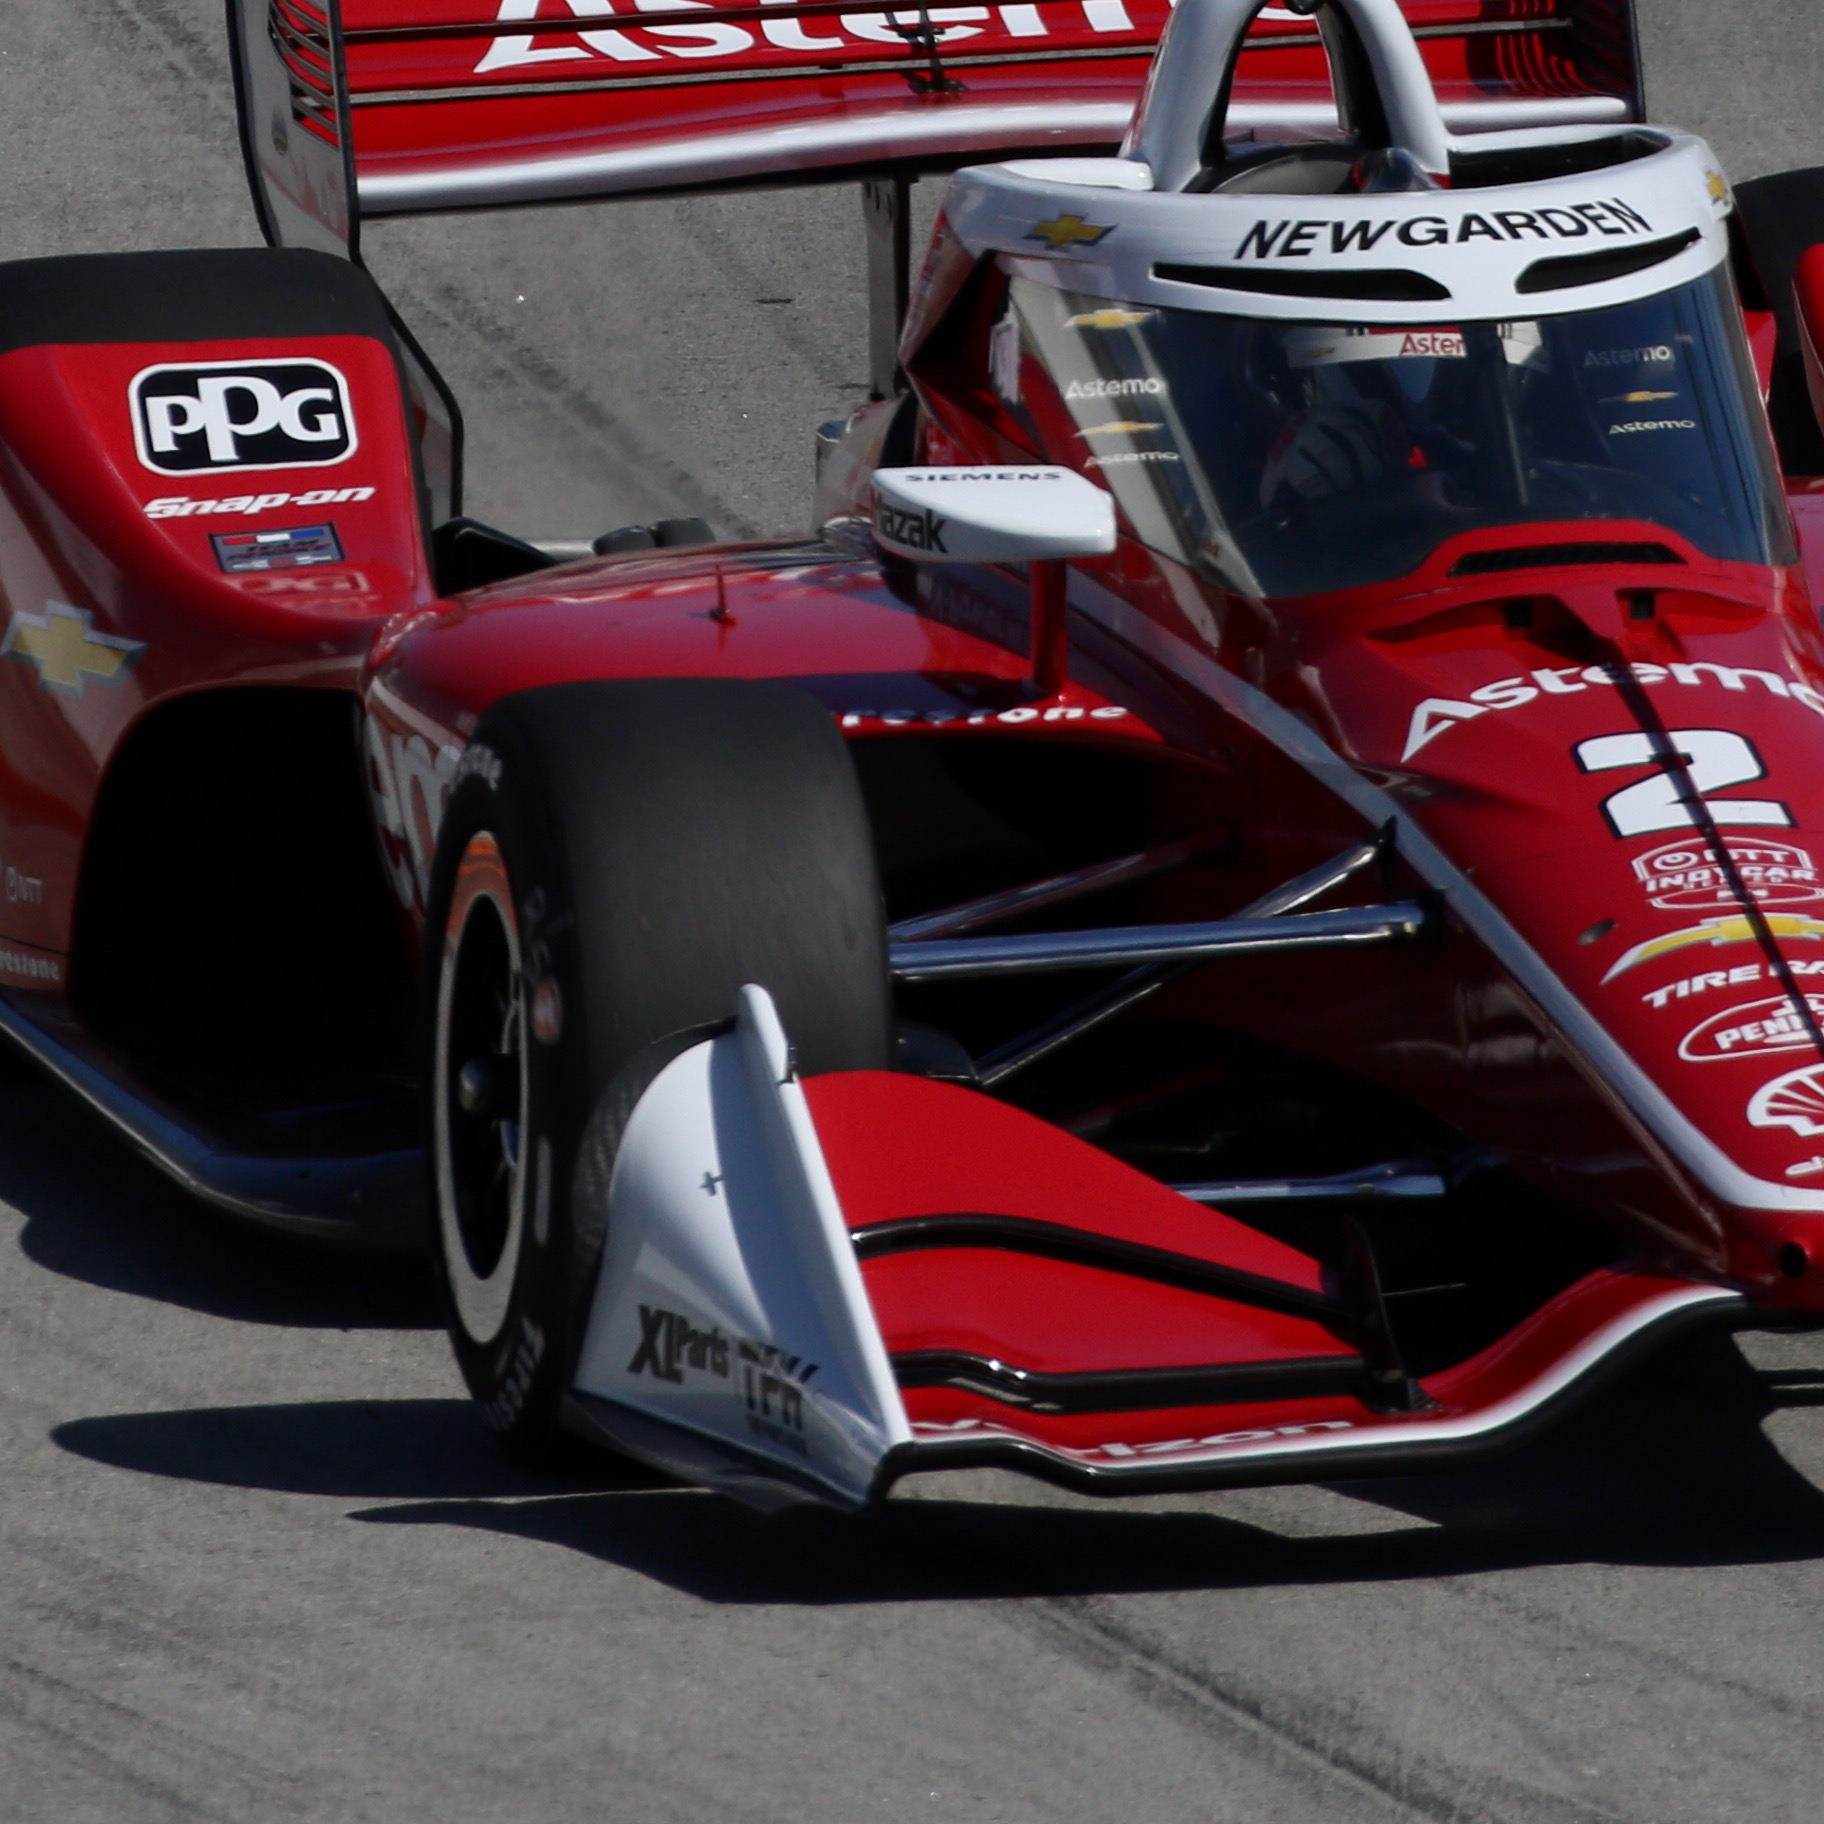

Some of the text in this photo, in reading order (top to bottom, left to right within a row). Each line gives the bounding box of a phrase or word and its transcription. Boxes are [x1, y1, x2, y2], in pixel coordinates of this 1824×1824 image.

[1233, 197, 1654, 261] NEWGARDEN
[1064, 378, 1163, 400] Astemo
[144, 375, 341, 462] PPG
[1607, 418, 1697, 435] Astemo
[904, 471, 1062, 483] SIEMENS
[143, 486, 376, 520] Snap-on
[1572, 727, 1798, 840] 2
[1645, 864, 1820, 893] INDYCAR
[1641, 963, 1761, 1009] TIRE
